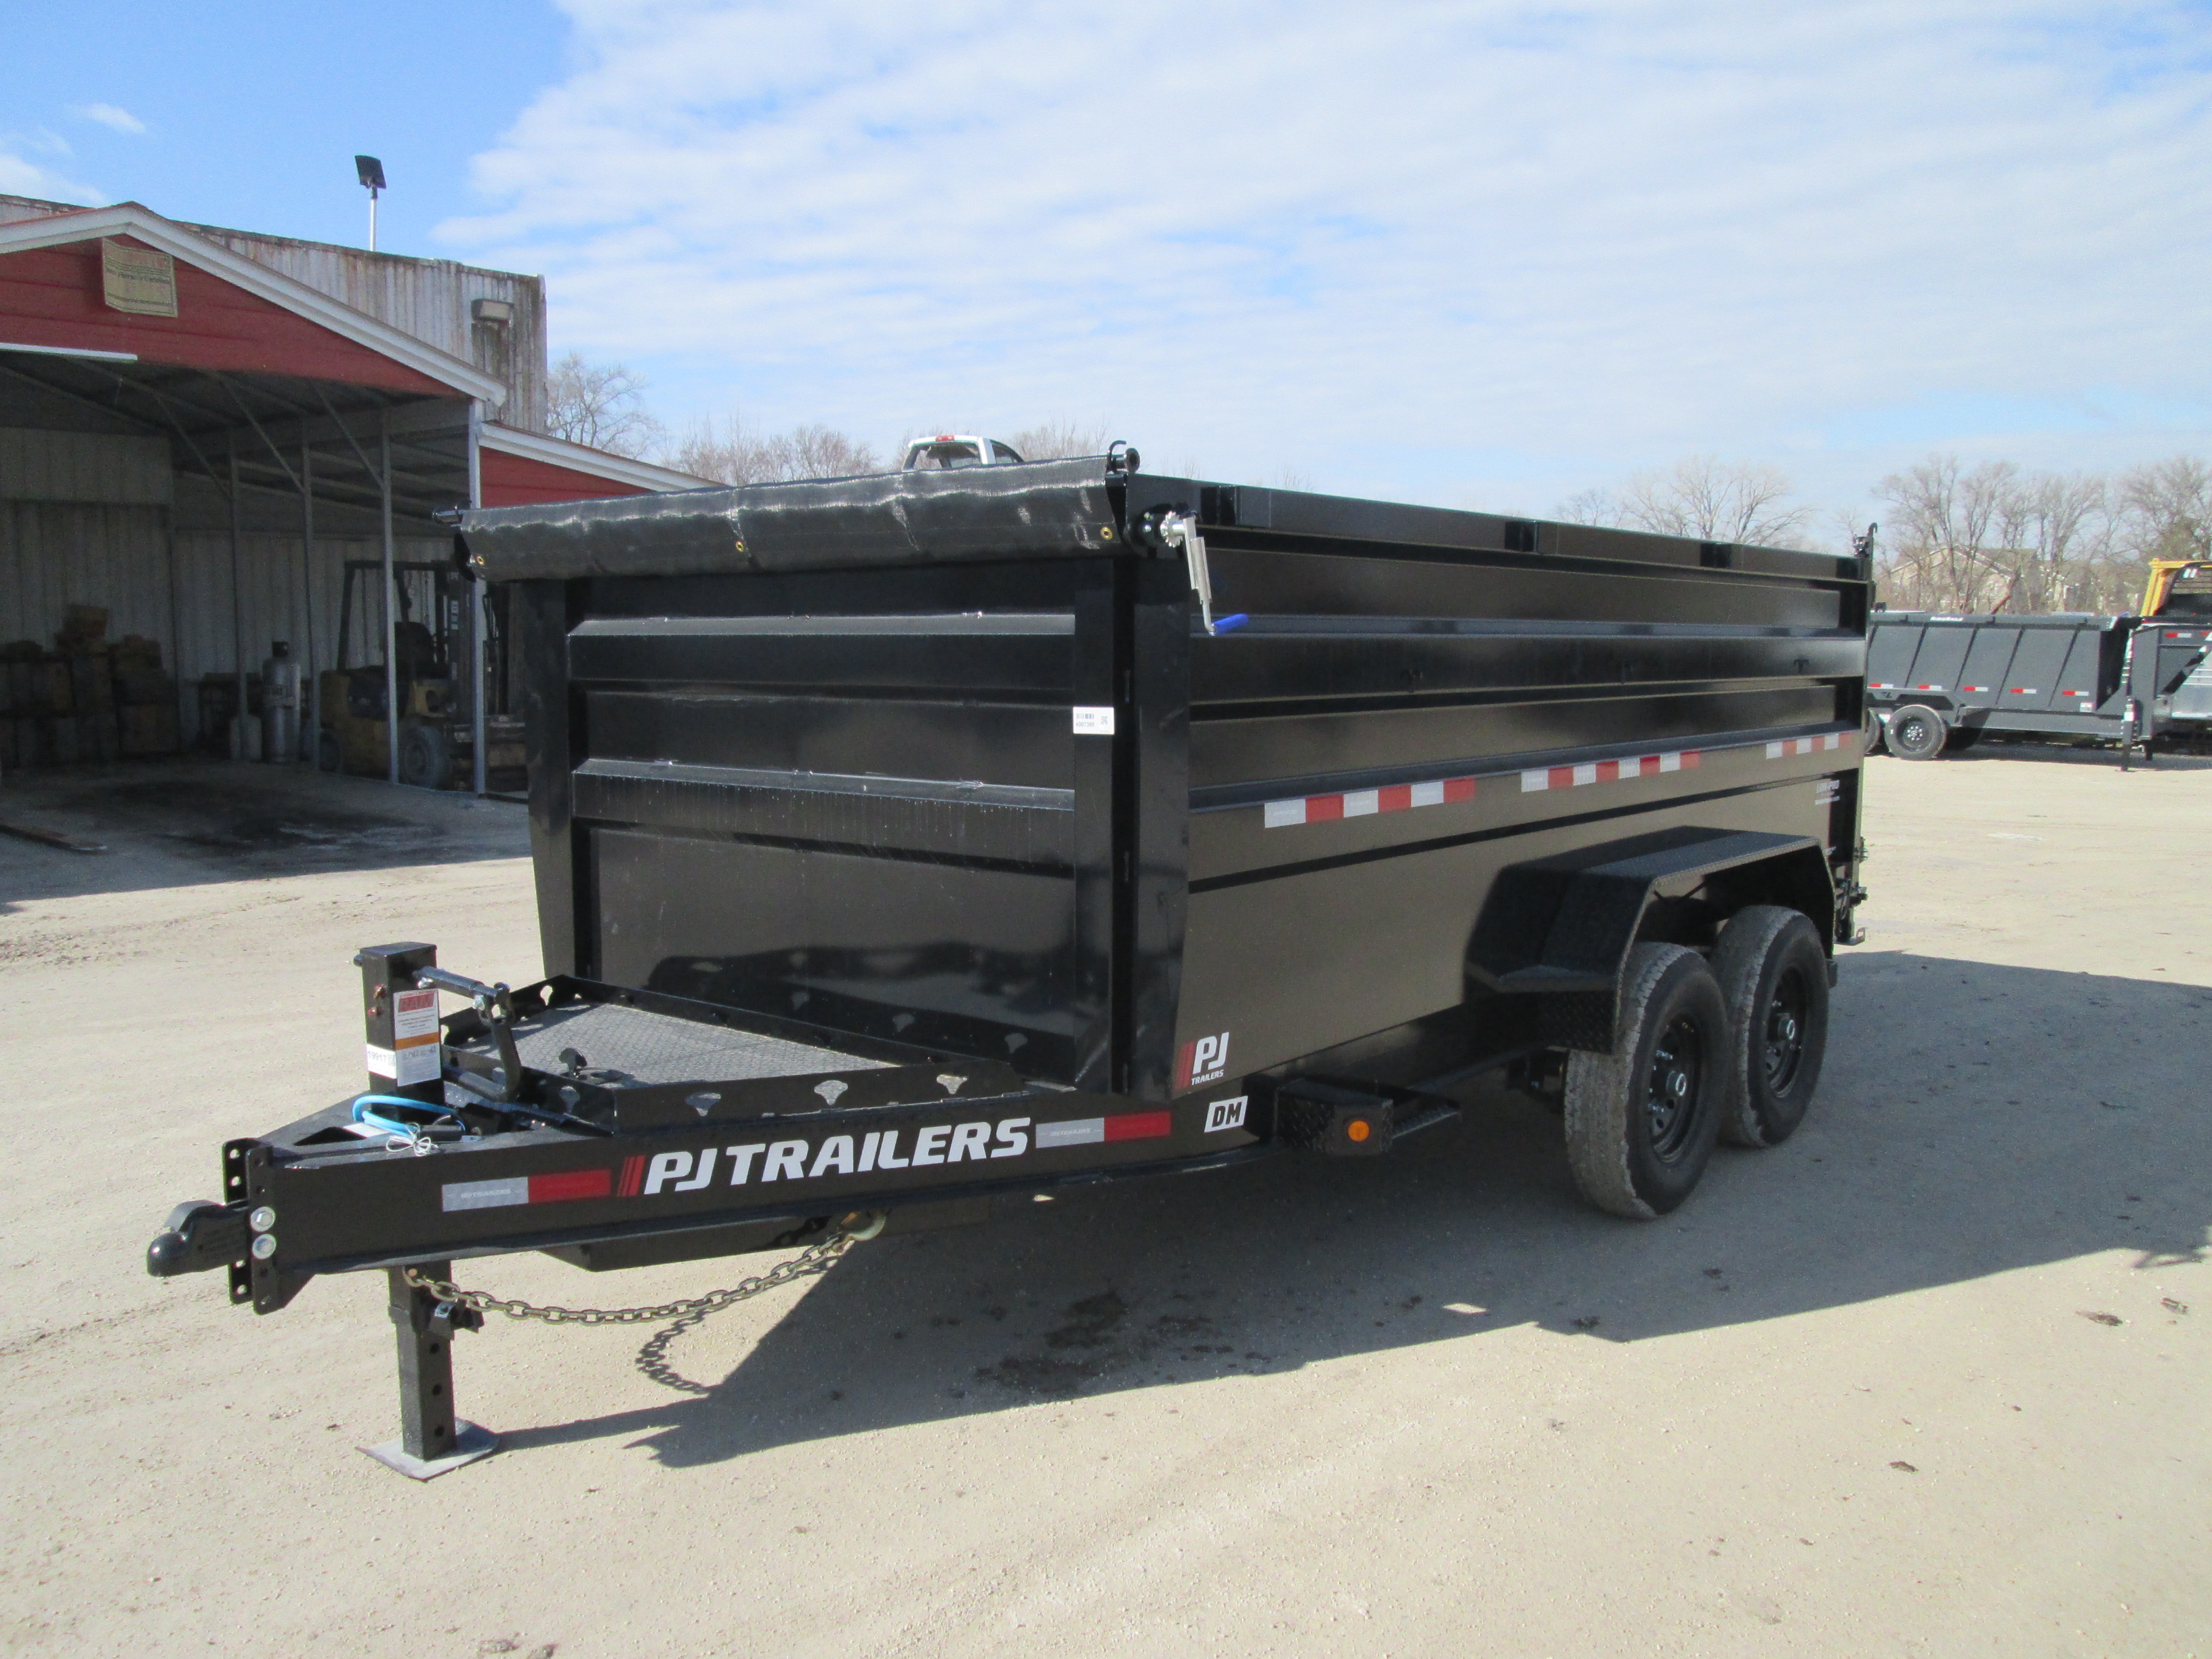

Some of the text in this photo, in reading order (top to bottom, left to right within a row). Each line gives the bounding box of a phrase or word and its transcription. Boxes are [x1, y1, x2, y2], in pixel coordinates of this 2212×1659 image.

[367, 1050, 387, 1063] 19917
[1192, 1031, 1230, 1075] PJ
[1191, 1069, 1225, 1086] TRAILERS
[1211, 1101, 1242, 1128] DM
[725, 1117, 1031, 1186] TRAILERS
